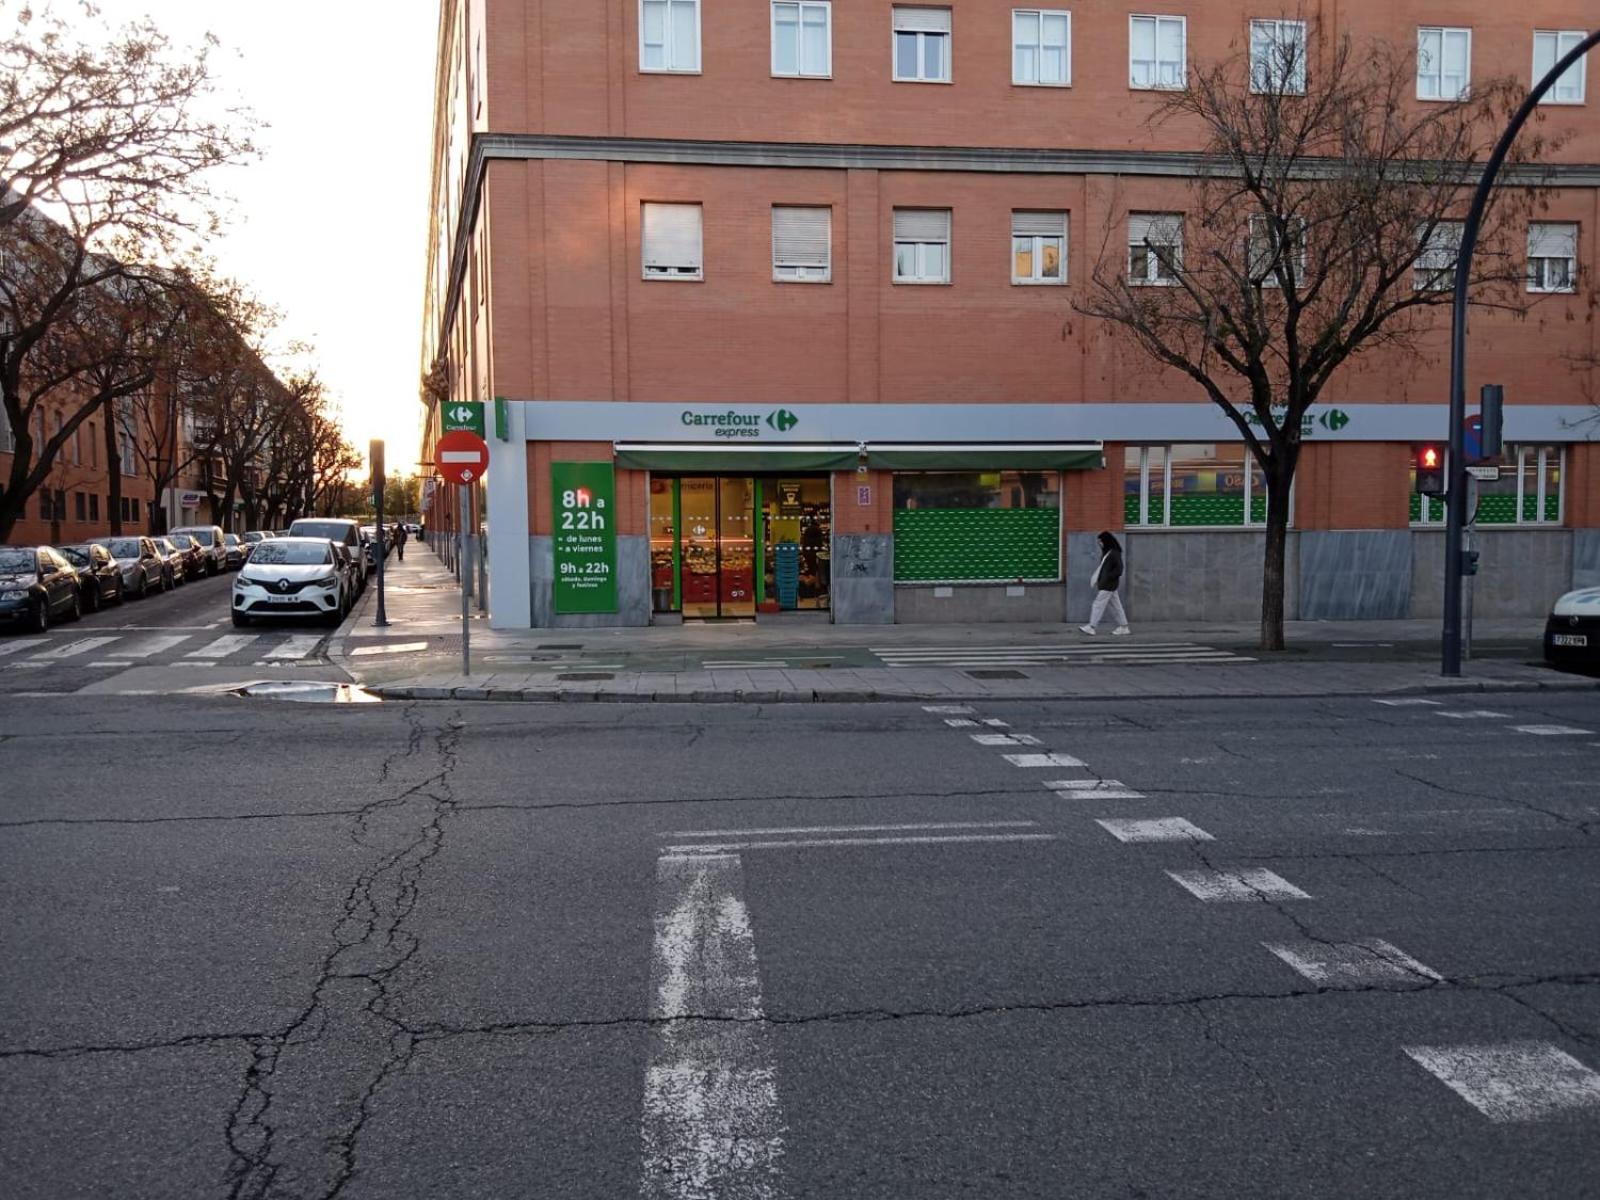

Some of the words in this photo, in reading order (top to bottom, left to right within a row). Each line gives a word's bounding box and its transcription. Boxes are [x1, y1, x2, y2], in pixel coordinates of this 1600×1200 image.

[681, 410, 761, 426] Carrefour
[715, 427, 760, 438] express
[562, 488, 590, 508] 8h
[596, 498, 605, 508] a
[561, 511, 605, 530] 22h
[566, 534, 577, 543] de
[579, 534, 602, 543] lunes
[572, 544, 603, 552] viernes
[560, 562, 576, 573] 9h
[585, 562, 609, 573] 22h
